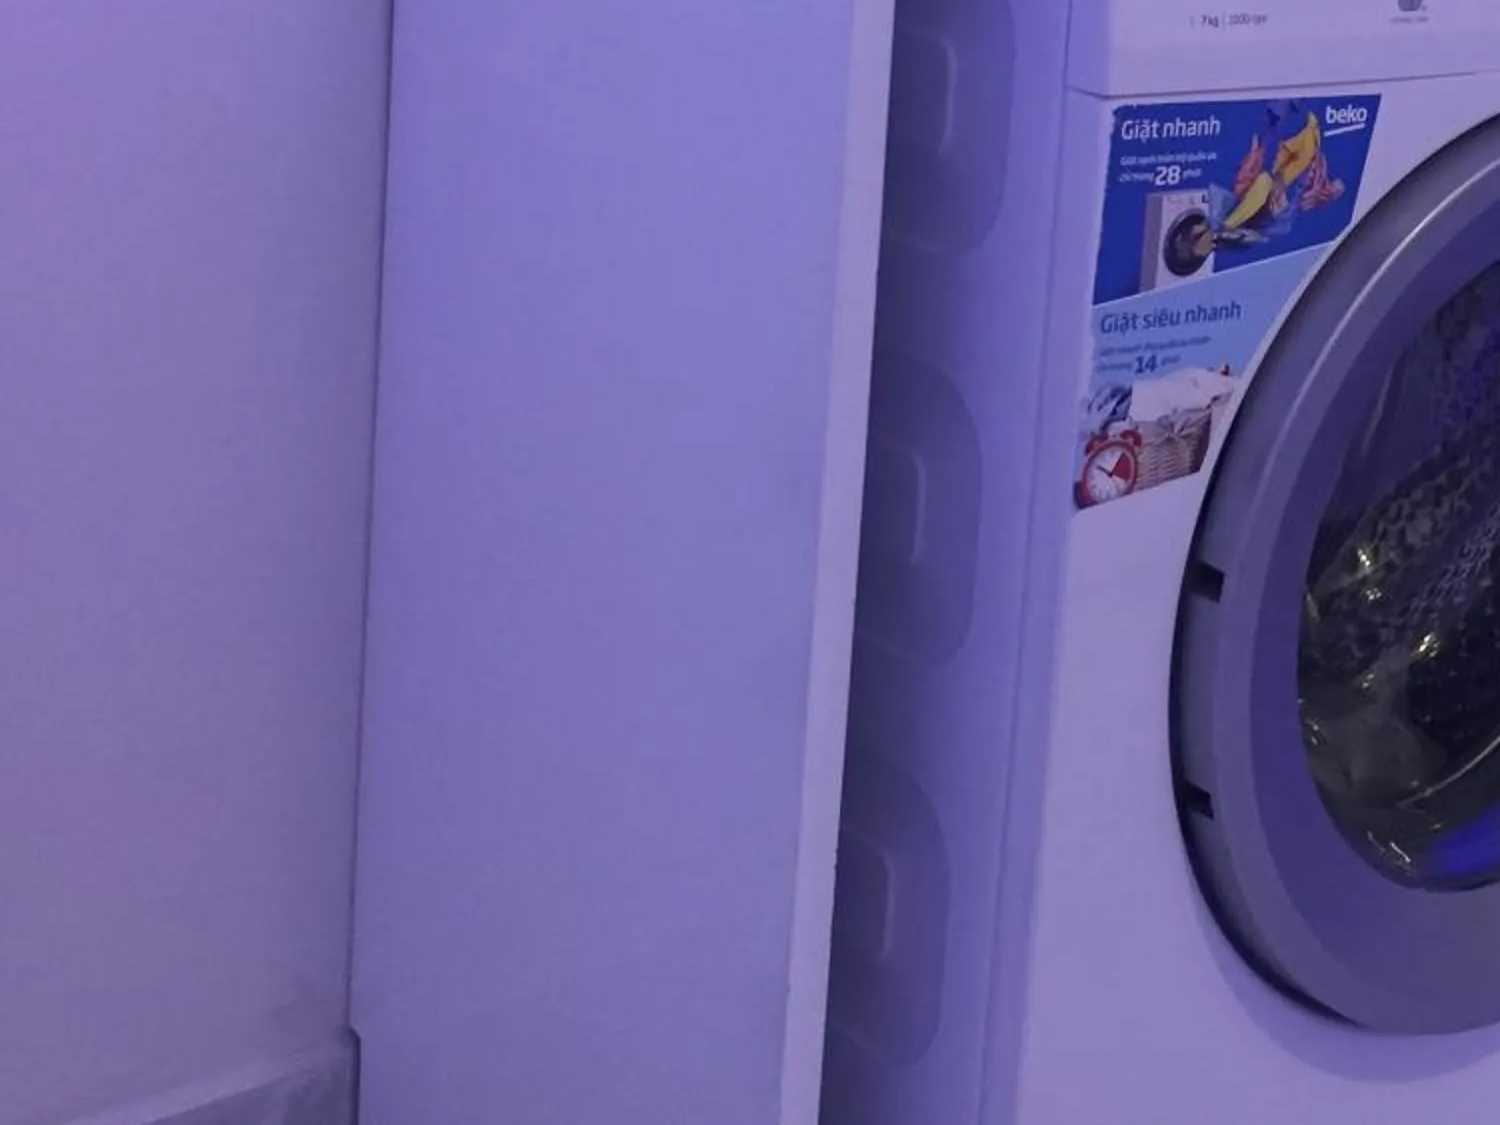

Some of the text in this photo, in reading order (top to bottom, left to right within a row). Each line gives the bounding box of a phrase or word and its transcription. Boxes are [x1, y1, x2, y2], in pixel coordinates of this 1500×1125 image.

[1325, 104, 1368, 124] beko
[1162, 115, 1222, 138] nhanh
[1155, 164, 1181, 186] 28
[1184, 300, 1242, 324] nhanh
[1135, 354, 1158, 374] 14
